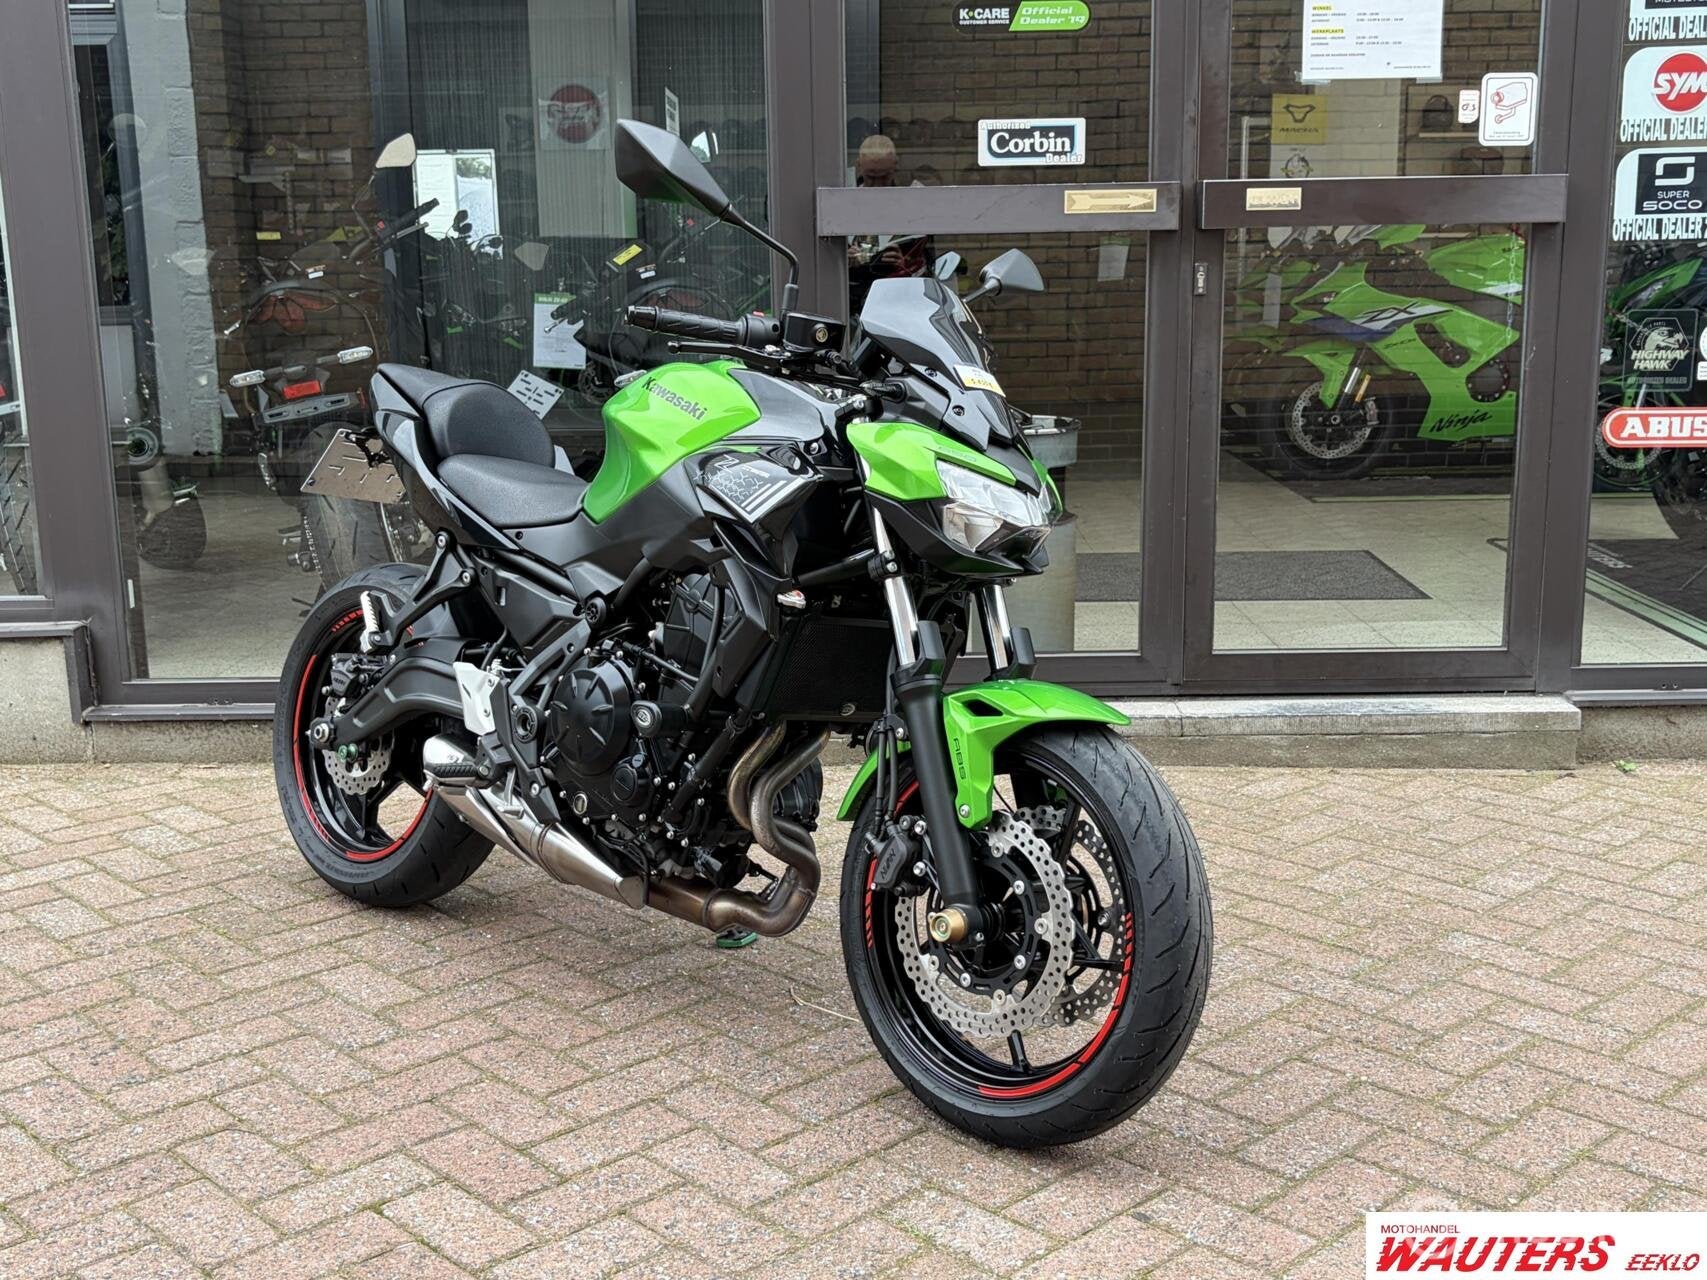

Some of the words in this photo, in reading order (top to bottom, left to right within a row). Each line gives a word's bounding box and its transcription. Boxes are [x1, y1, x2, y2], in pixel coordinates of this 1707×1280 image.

[1020, 17, 1065, 25] Dealer
[1021, 6, 1073, 15] Official
[1628, 15, 1677, 41] OFFICIAL
[1620, 118, 1667, 142] OFFICIAL
[990, 130, 1071, 154] Corbin
[1045, 152, 1083, 164] Dealer
[1642, 199, 1703, 211] SOCO
[1657, 190, 1690, 199] SUPER
[1612, 217, 1660, 241] OFFICIAL
[1661, 215, 1702, 240] DEALER
[1630, 349, 1690, 360] HIGHWAY
[1633, 359, 1669, 370] HAWK
[641, 376, 708, 421] Kawasaki
[1429, 408, 1493, 433] Ninja
[1620, 415, 1707, 438] ABUS
[952, 737, 967, 781] ABS
